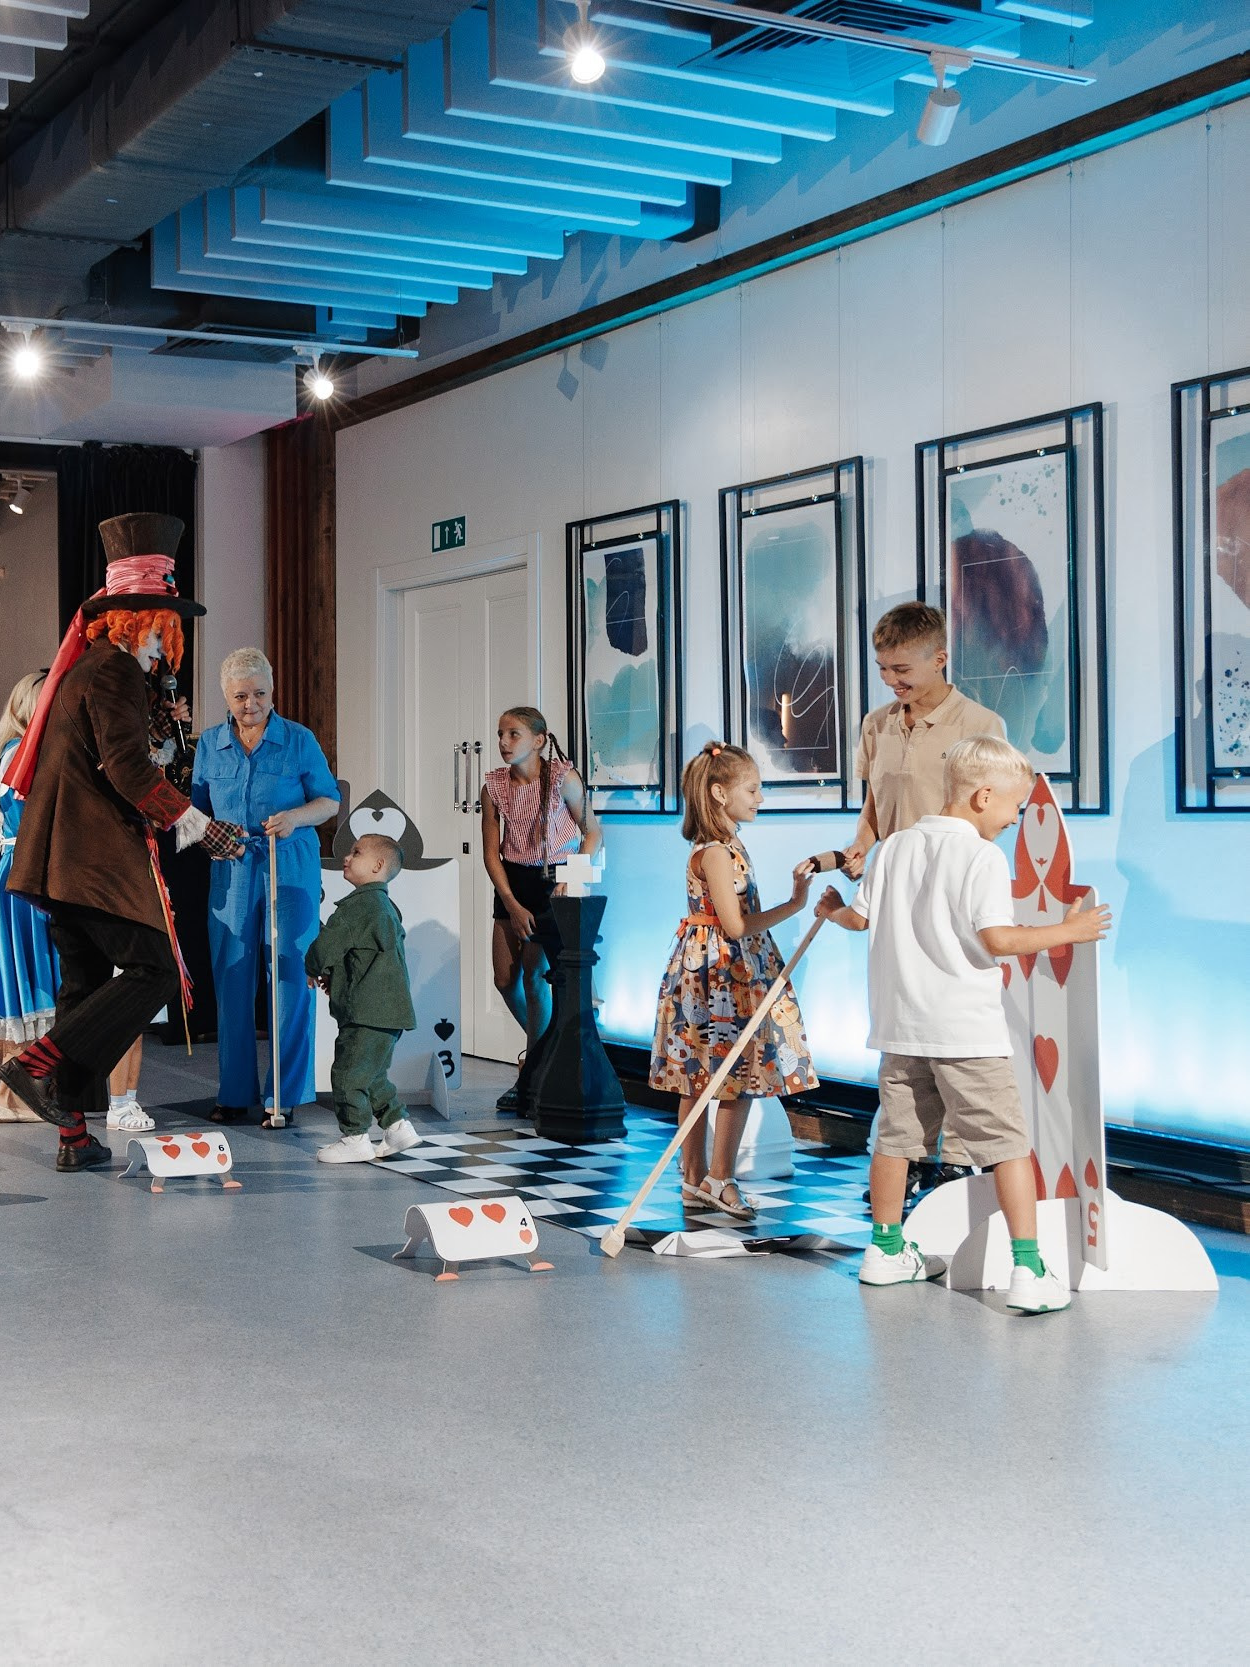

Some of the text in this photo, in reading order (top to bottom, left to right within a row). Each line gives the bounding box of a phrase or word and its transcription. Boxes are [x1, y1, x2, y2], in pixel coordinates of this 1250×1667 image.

[218, 1144, 225, 1152] 6
[519, 1217, 528, 1227] 4
[1087, 1201, 1099, 1248] 5
